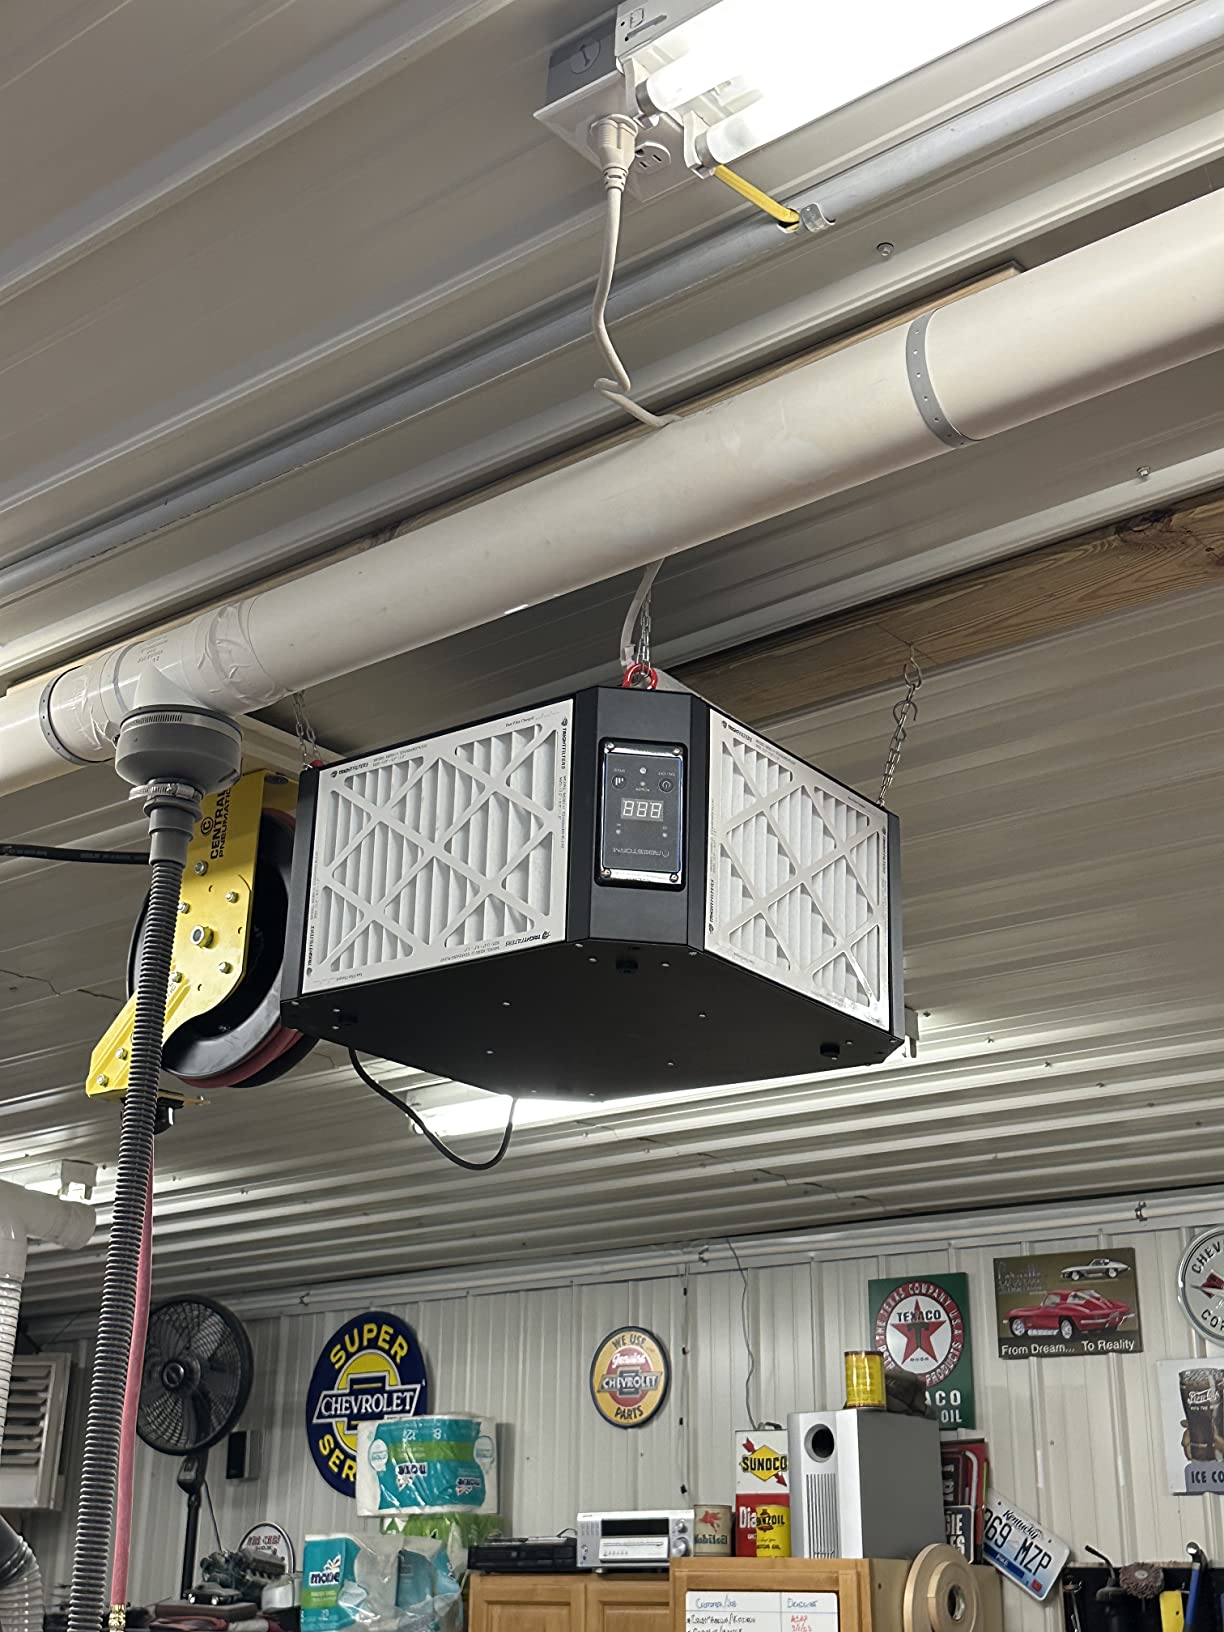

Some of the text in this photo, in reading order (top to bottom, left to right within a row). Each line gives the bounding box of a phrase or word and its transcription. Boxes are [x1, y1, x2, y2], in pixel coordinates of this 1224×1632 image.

[210, 790, 228, 860] CENTRAL
[217, 787, 232, 859] PNEUMATIC
[880, 1286, 906, 1318] TEXAS
[907, 1282, 952, 1307] COMPANY
[896, 1309, 942, 1323] TEXACO
[329, 1322, 409, 1370] SUPER
[611, 1334, 628, 1350] WE
[1001, 1339, 1136, 1356] From Dream... To Reality
[602, 1375, 657, 1389] CHEVROLET
[320, 1391, 415, 1417] CHEVROLET
[614, 1405, 645, 1420] PARTS
[940, 1409, 963, 1424] OIL
[741, 1455, 788, 1472] SUNOCO
[1190, 1470, 1207, 1484] ICE
[1002, 1509, 1042, 1540] Kentucky
[1013, 1537, 1052, 1576] MZP
